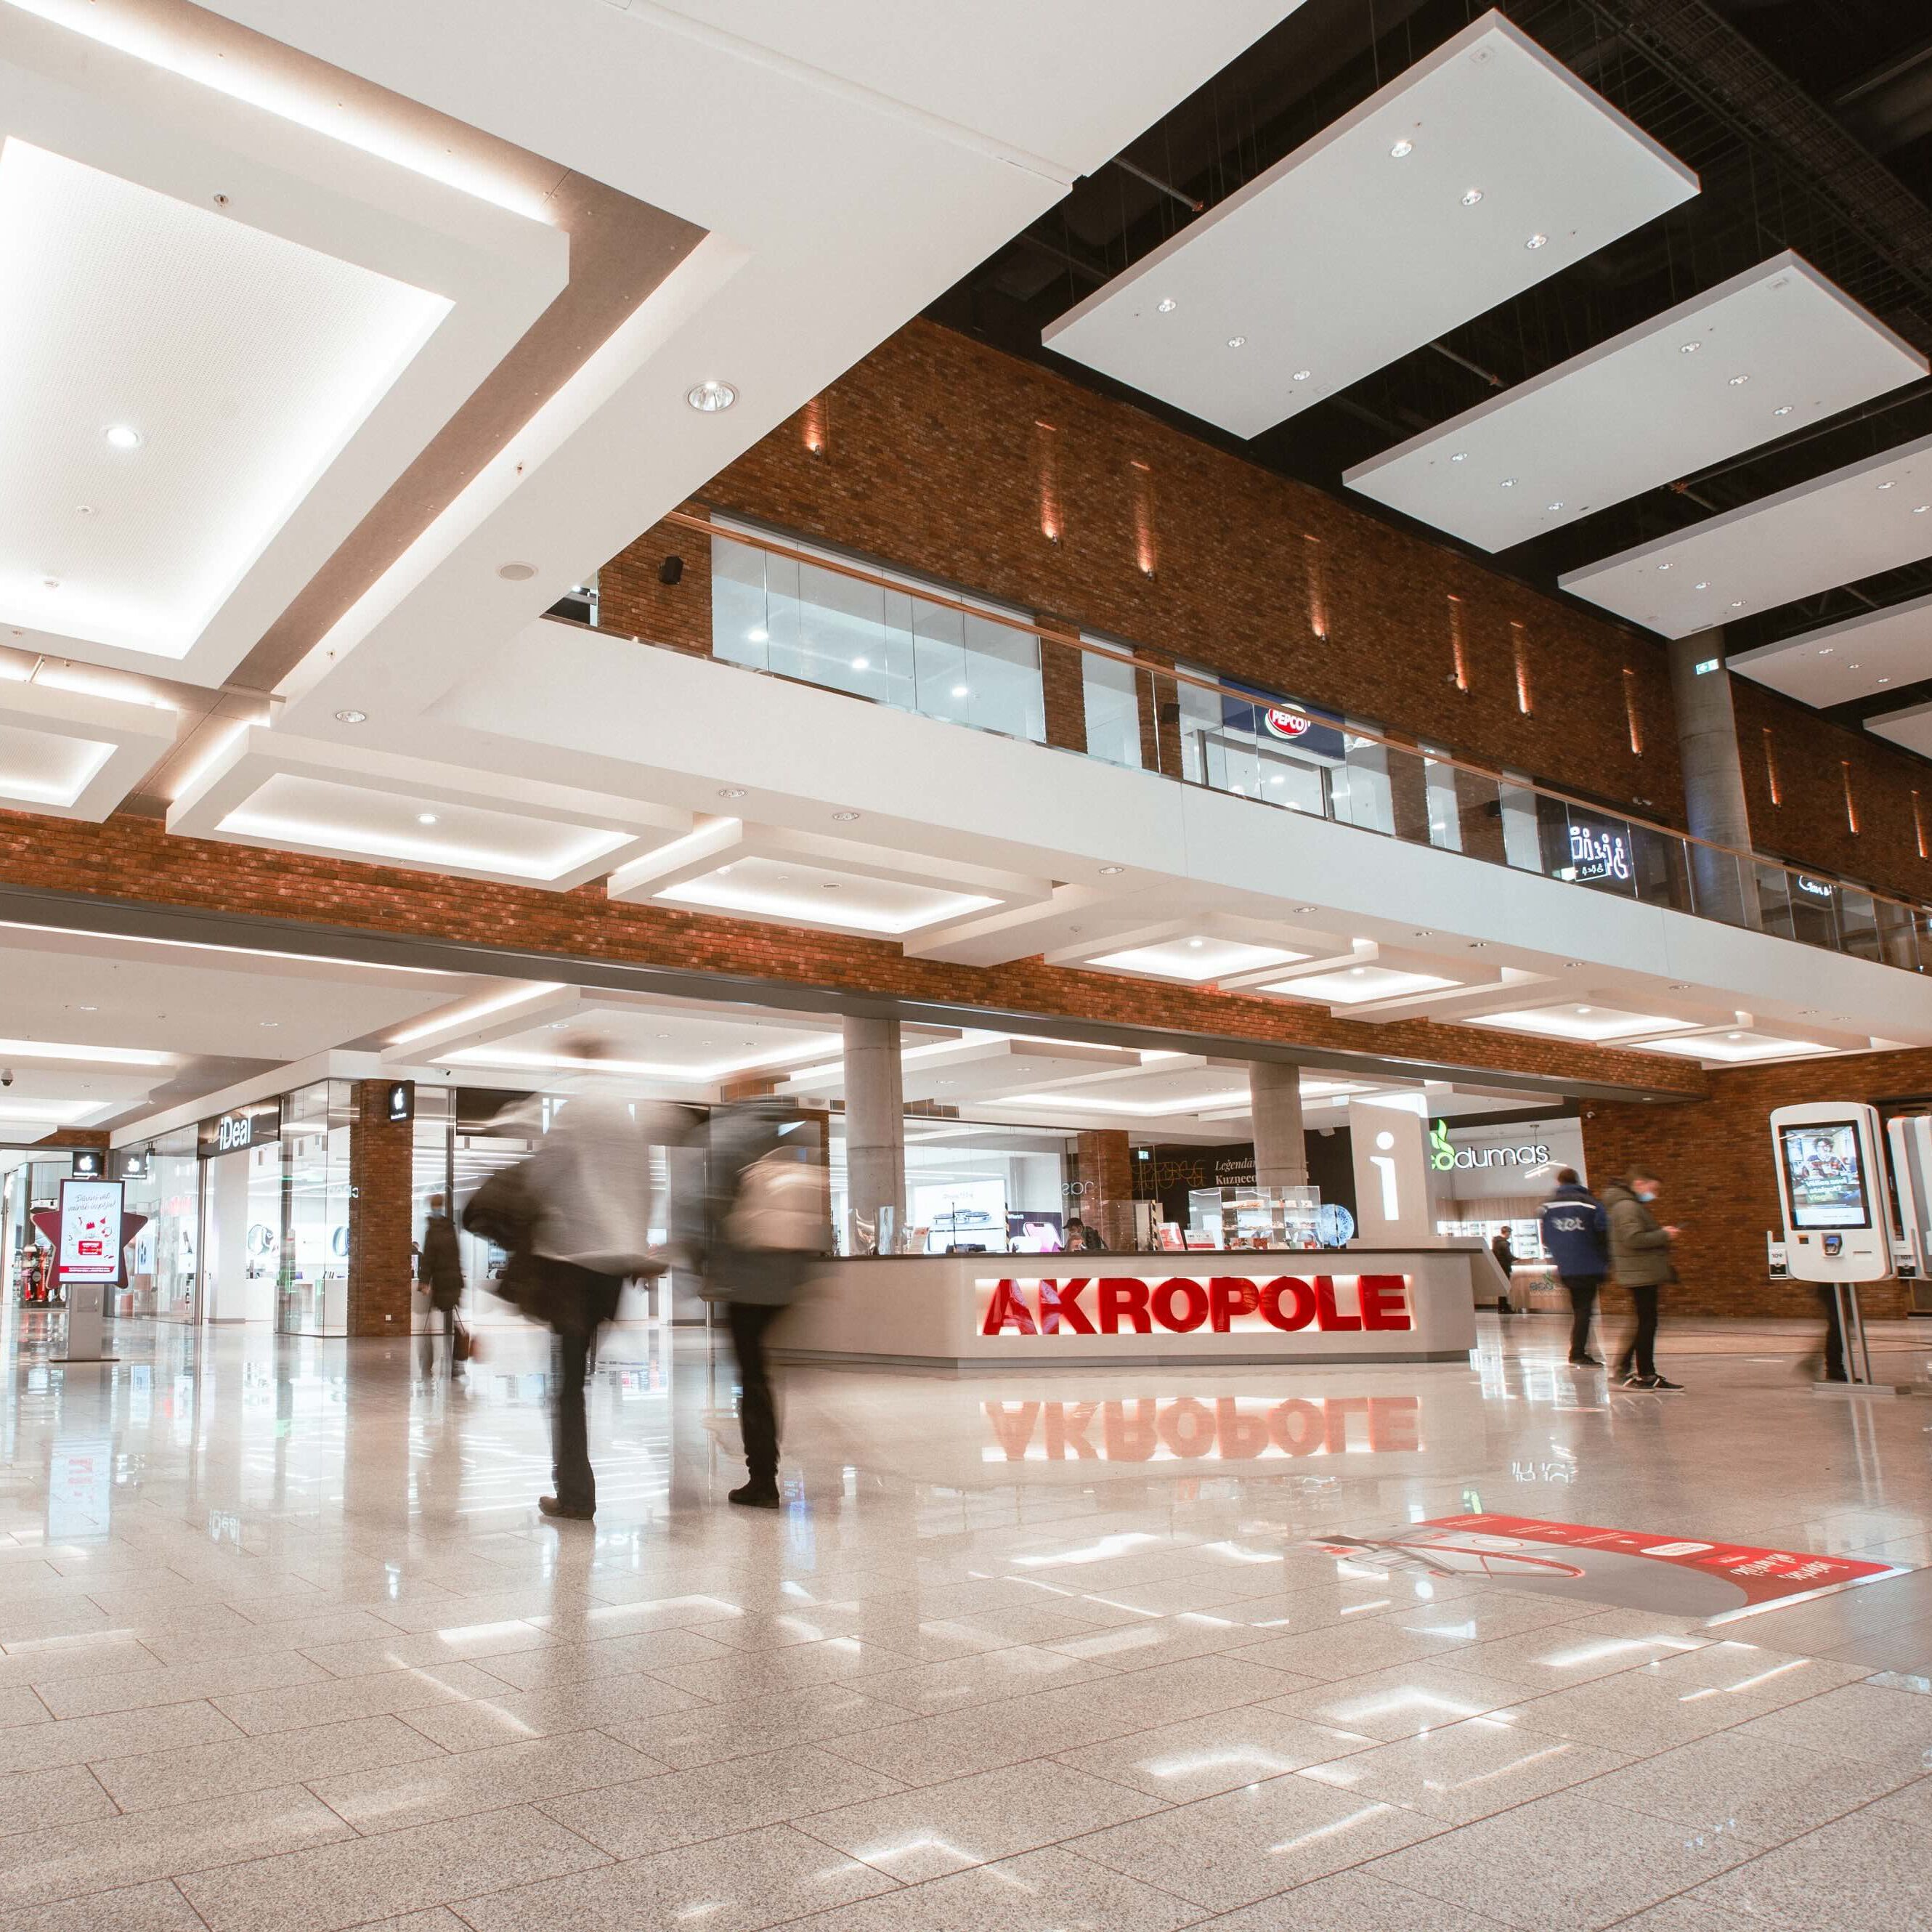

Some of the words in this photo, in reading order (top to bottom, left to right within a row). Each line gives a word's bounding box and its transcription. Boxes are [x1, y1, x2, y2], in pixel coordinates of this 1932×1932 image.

[1272, 709, 1304, 731] PEPCO
[219, 1110, 251, 1150] iDeal
[1214, 1158, 1256, 1172] Leģendā
[1215, 1174, 1257, 1185] Kuzņeco
[983, 1275, 1411, 1335] AKROPOLE
